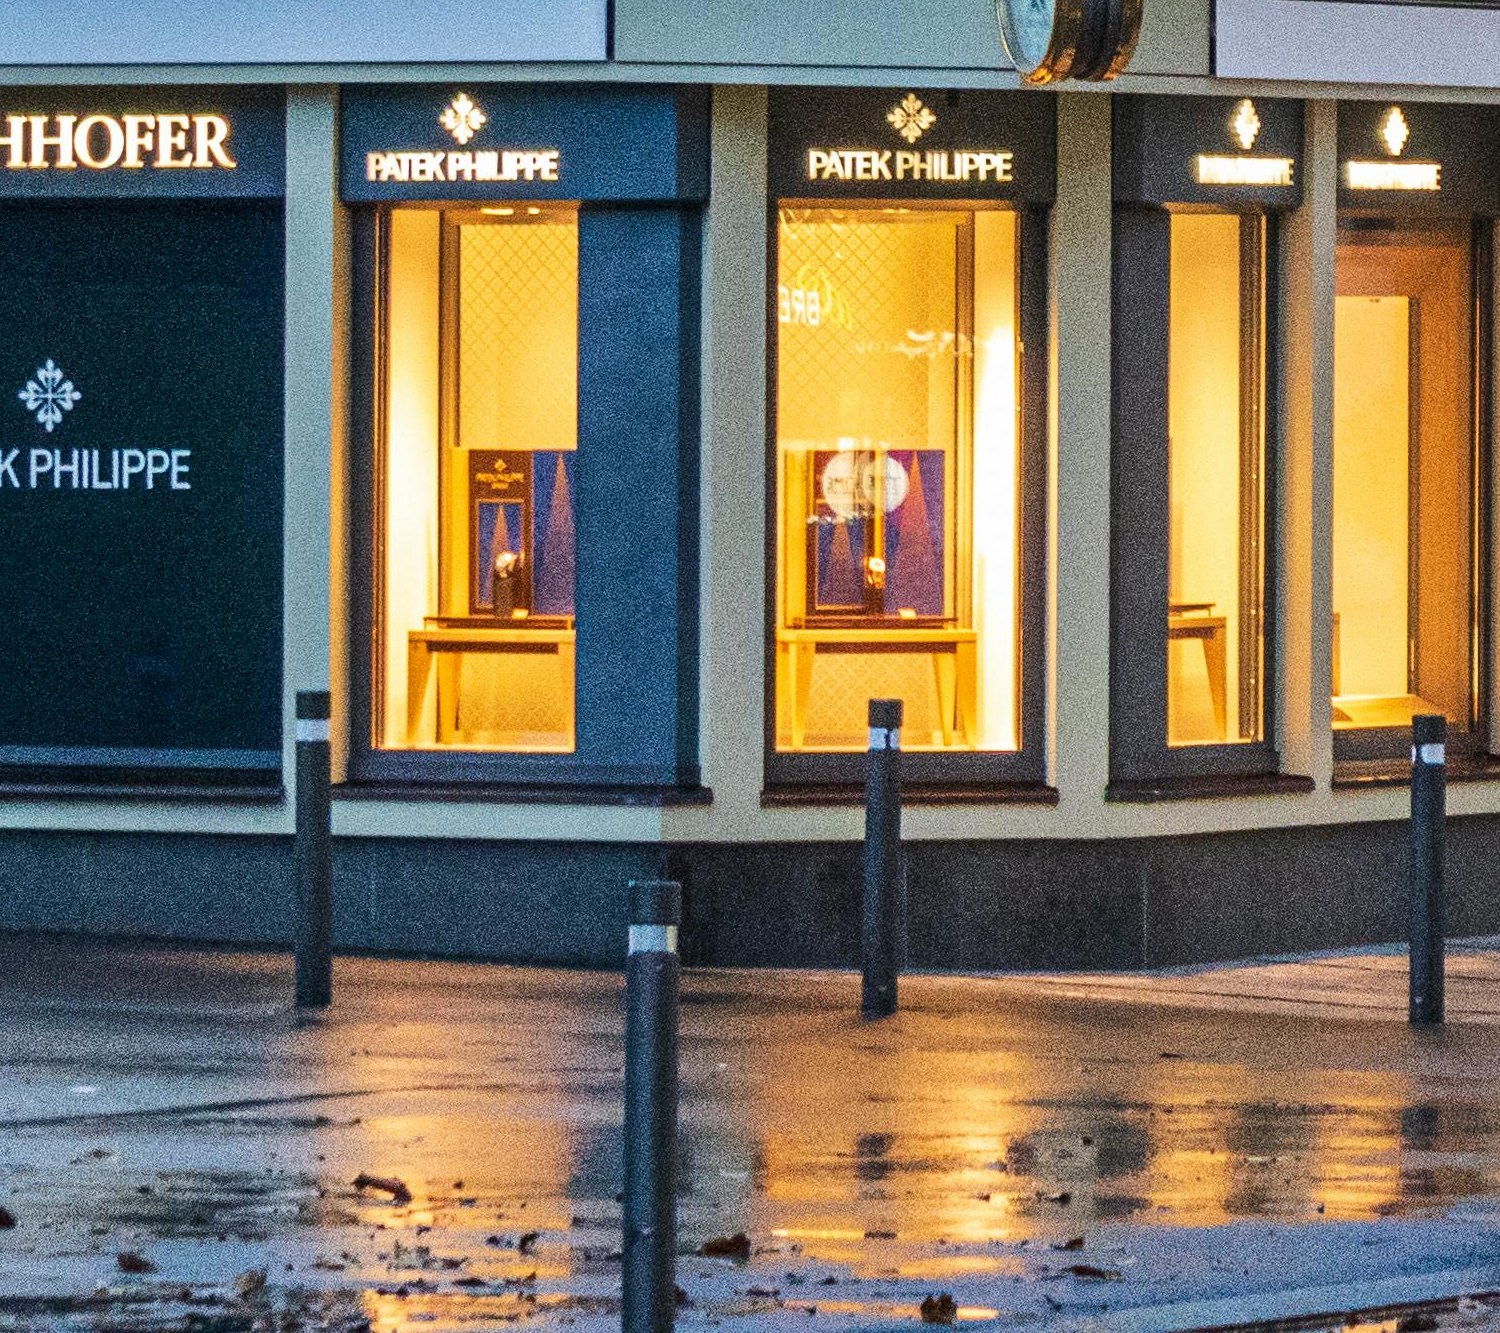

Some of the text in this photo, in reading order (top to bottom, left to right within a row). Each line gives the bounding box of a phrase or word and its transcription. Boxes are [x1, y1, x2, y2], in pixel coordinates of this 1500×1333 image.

[366, 150, 559, 181] PATEK PHILIPPE
[808, 150, 1013, 181] PATEK PHILIPPE
[29, 448, 191, 490] PHILIPPE
